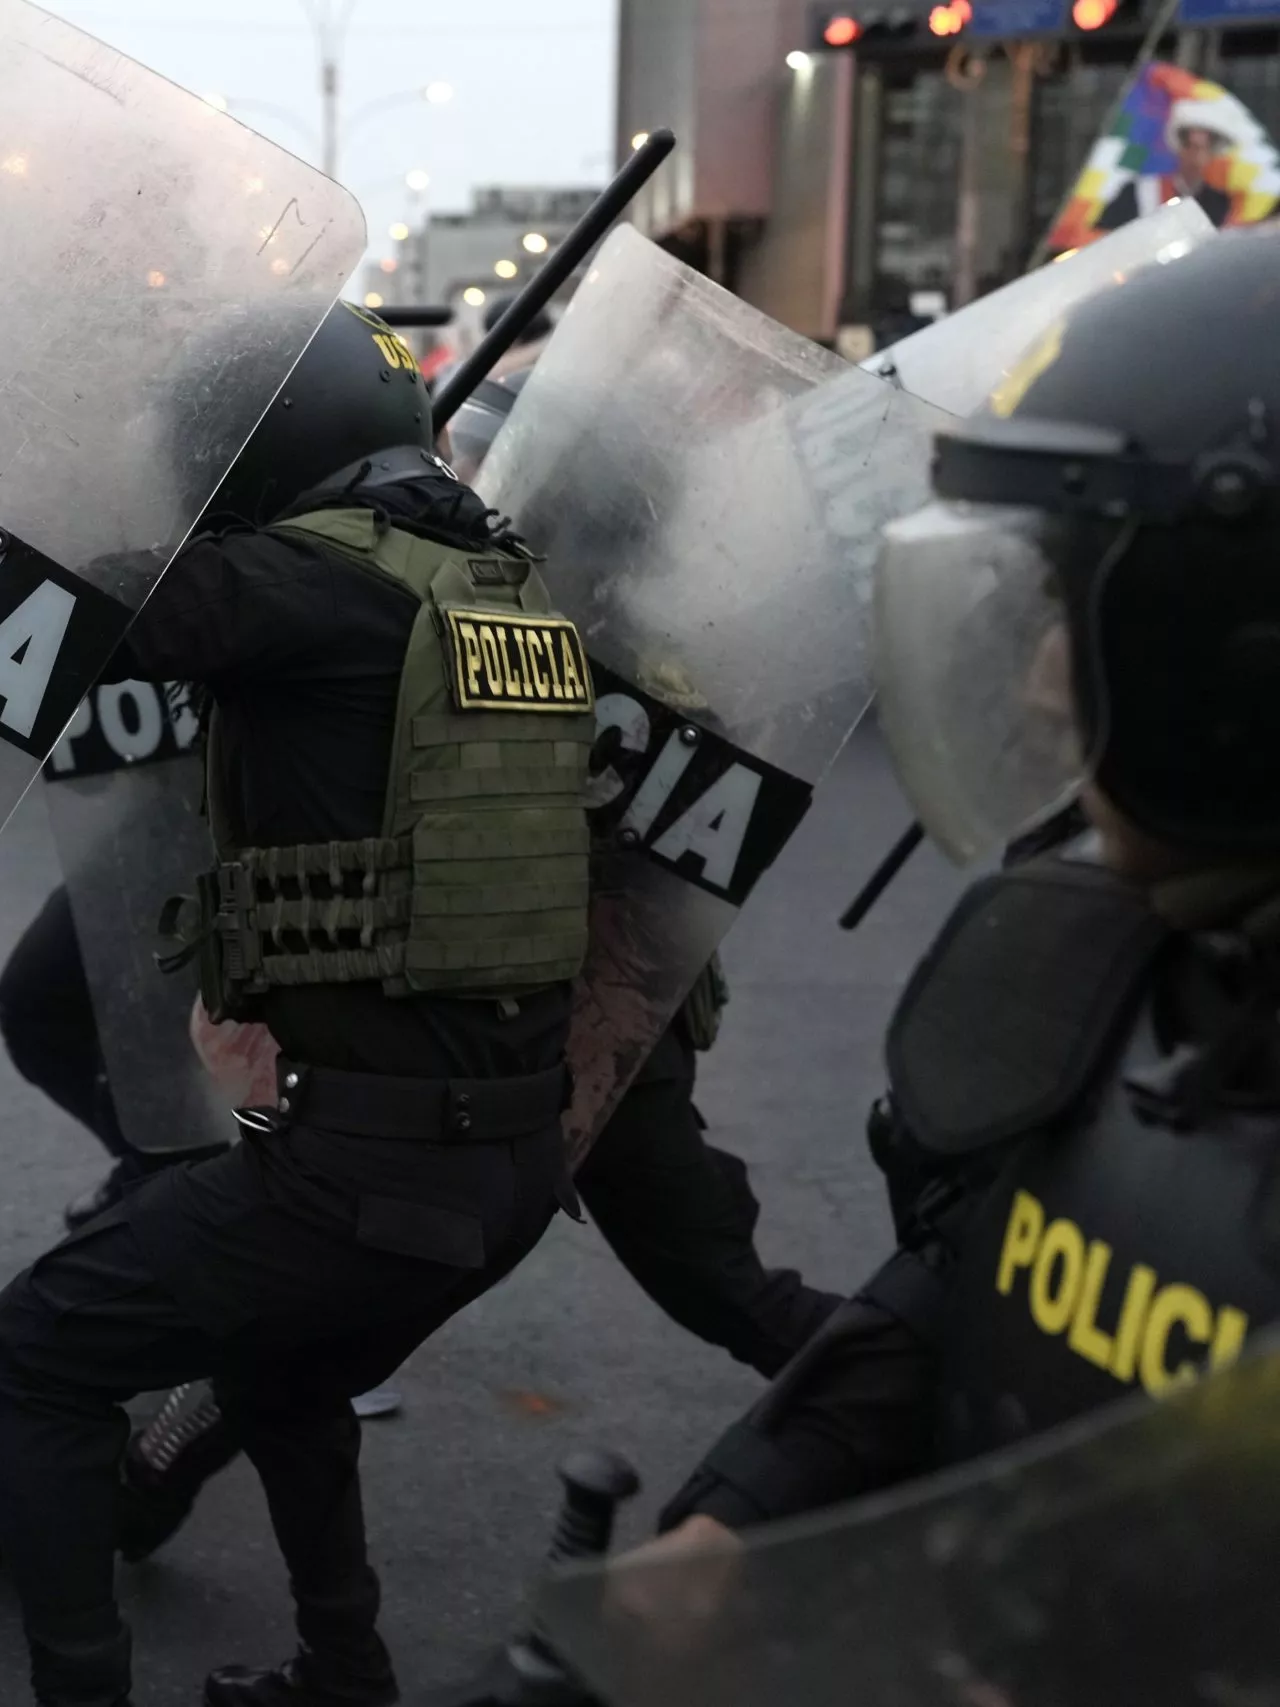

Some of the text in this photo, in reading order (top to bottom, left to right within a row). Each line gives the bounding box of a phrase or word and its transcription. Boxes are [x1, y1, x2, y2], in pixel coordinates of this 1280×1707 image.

[371, 333, 418, 372] US
[459, 622, 587, 699] POLICIA
[995, 1188, 1249, 1400] POLICI
